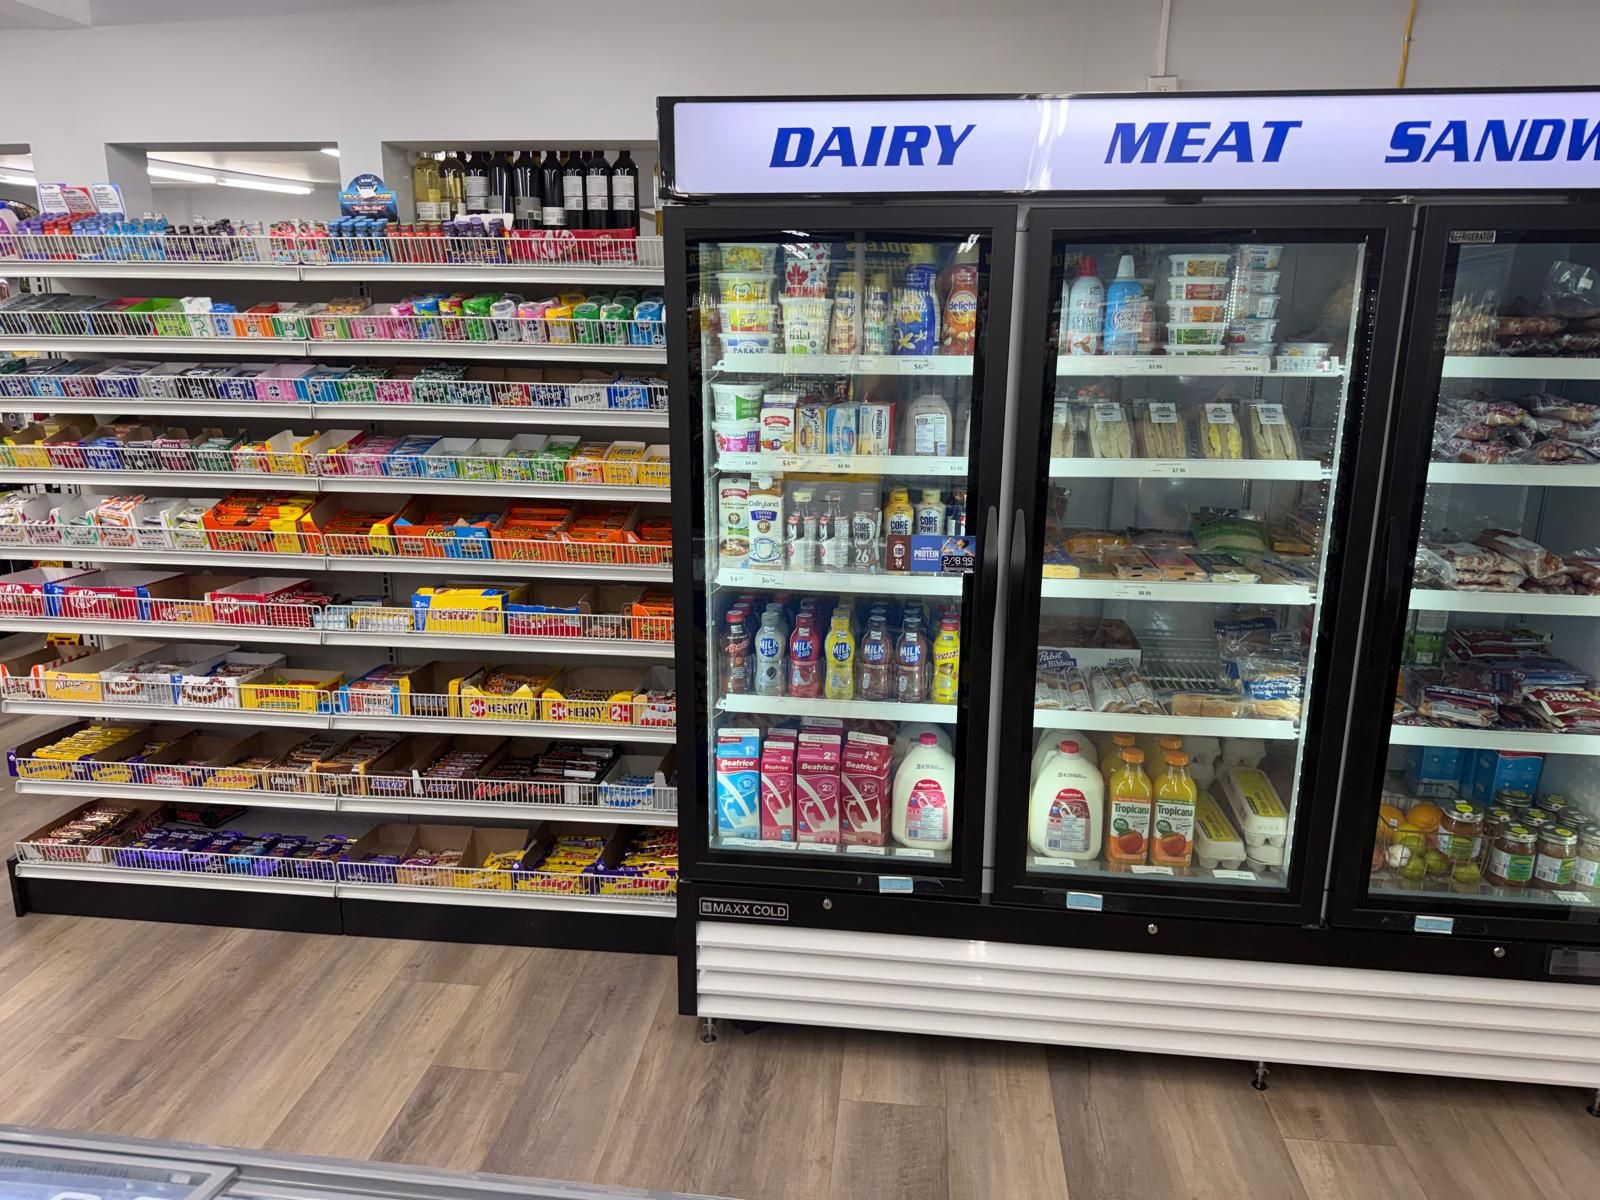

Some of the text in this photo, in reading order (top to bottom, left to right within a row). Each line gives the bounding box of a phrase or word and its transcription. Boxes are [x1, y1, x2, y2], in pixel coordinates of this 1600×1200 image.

[769, 124, 977, 168] DAIRY
[1104, 120, 1303, 164] MEAT
[1450, 231, 1495, 243] REFRIGERATOR
[948, 302, 977, 313] delight
[875, 409, 884, 440] PHILADELPHIA
[890, 520, 909, 530] CORE
[920, 515, 938, 526] CORE
[854, 522, 871, 532] CORE
[425, 528, 456, 538] Reese's
[854, 532, 871, 540] POWER
[914, 549, 939, 558] PROTEIN
[760, 638, 778, 649] MILK
[792, 640, 813, 652] MILK
[832, 643, 851, 654] MILK
[764, 648, 776, 656] 2GO
[864, 644, 885, 655] MILK
[900, 645, 921, 657] MILK
[470, 702, 528, 716] OH HENRY!
[550, 705, 608, 719] OH HENRY!
[721, 759, 755, 767] Beatrice
[764, 763, 789, 771] Beatrice
[801, 762, 836, 771] Beatrice
[845, 761, 879, 772] Beatrice
[473, 782, 521, 797] Mars
[1113, 803, 1149, 814] Tropicana
[1157, 804, 1193, 816] Tropicana
[45, 847, 80, 858] TWIX
[712, 902, 786, 917] MAXX COLD
